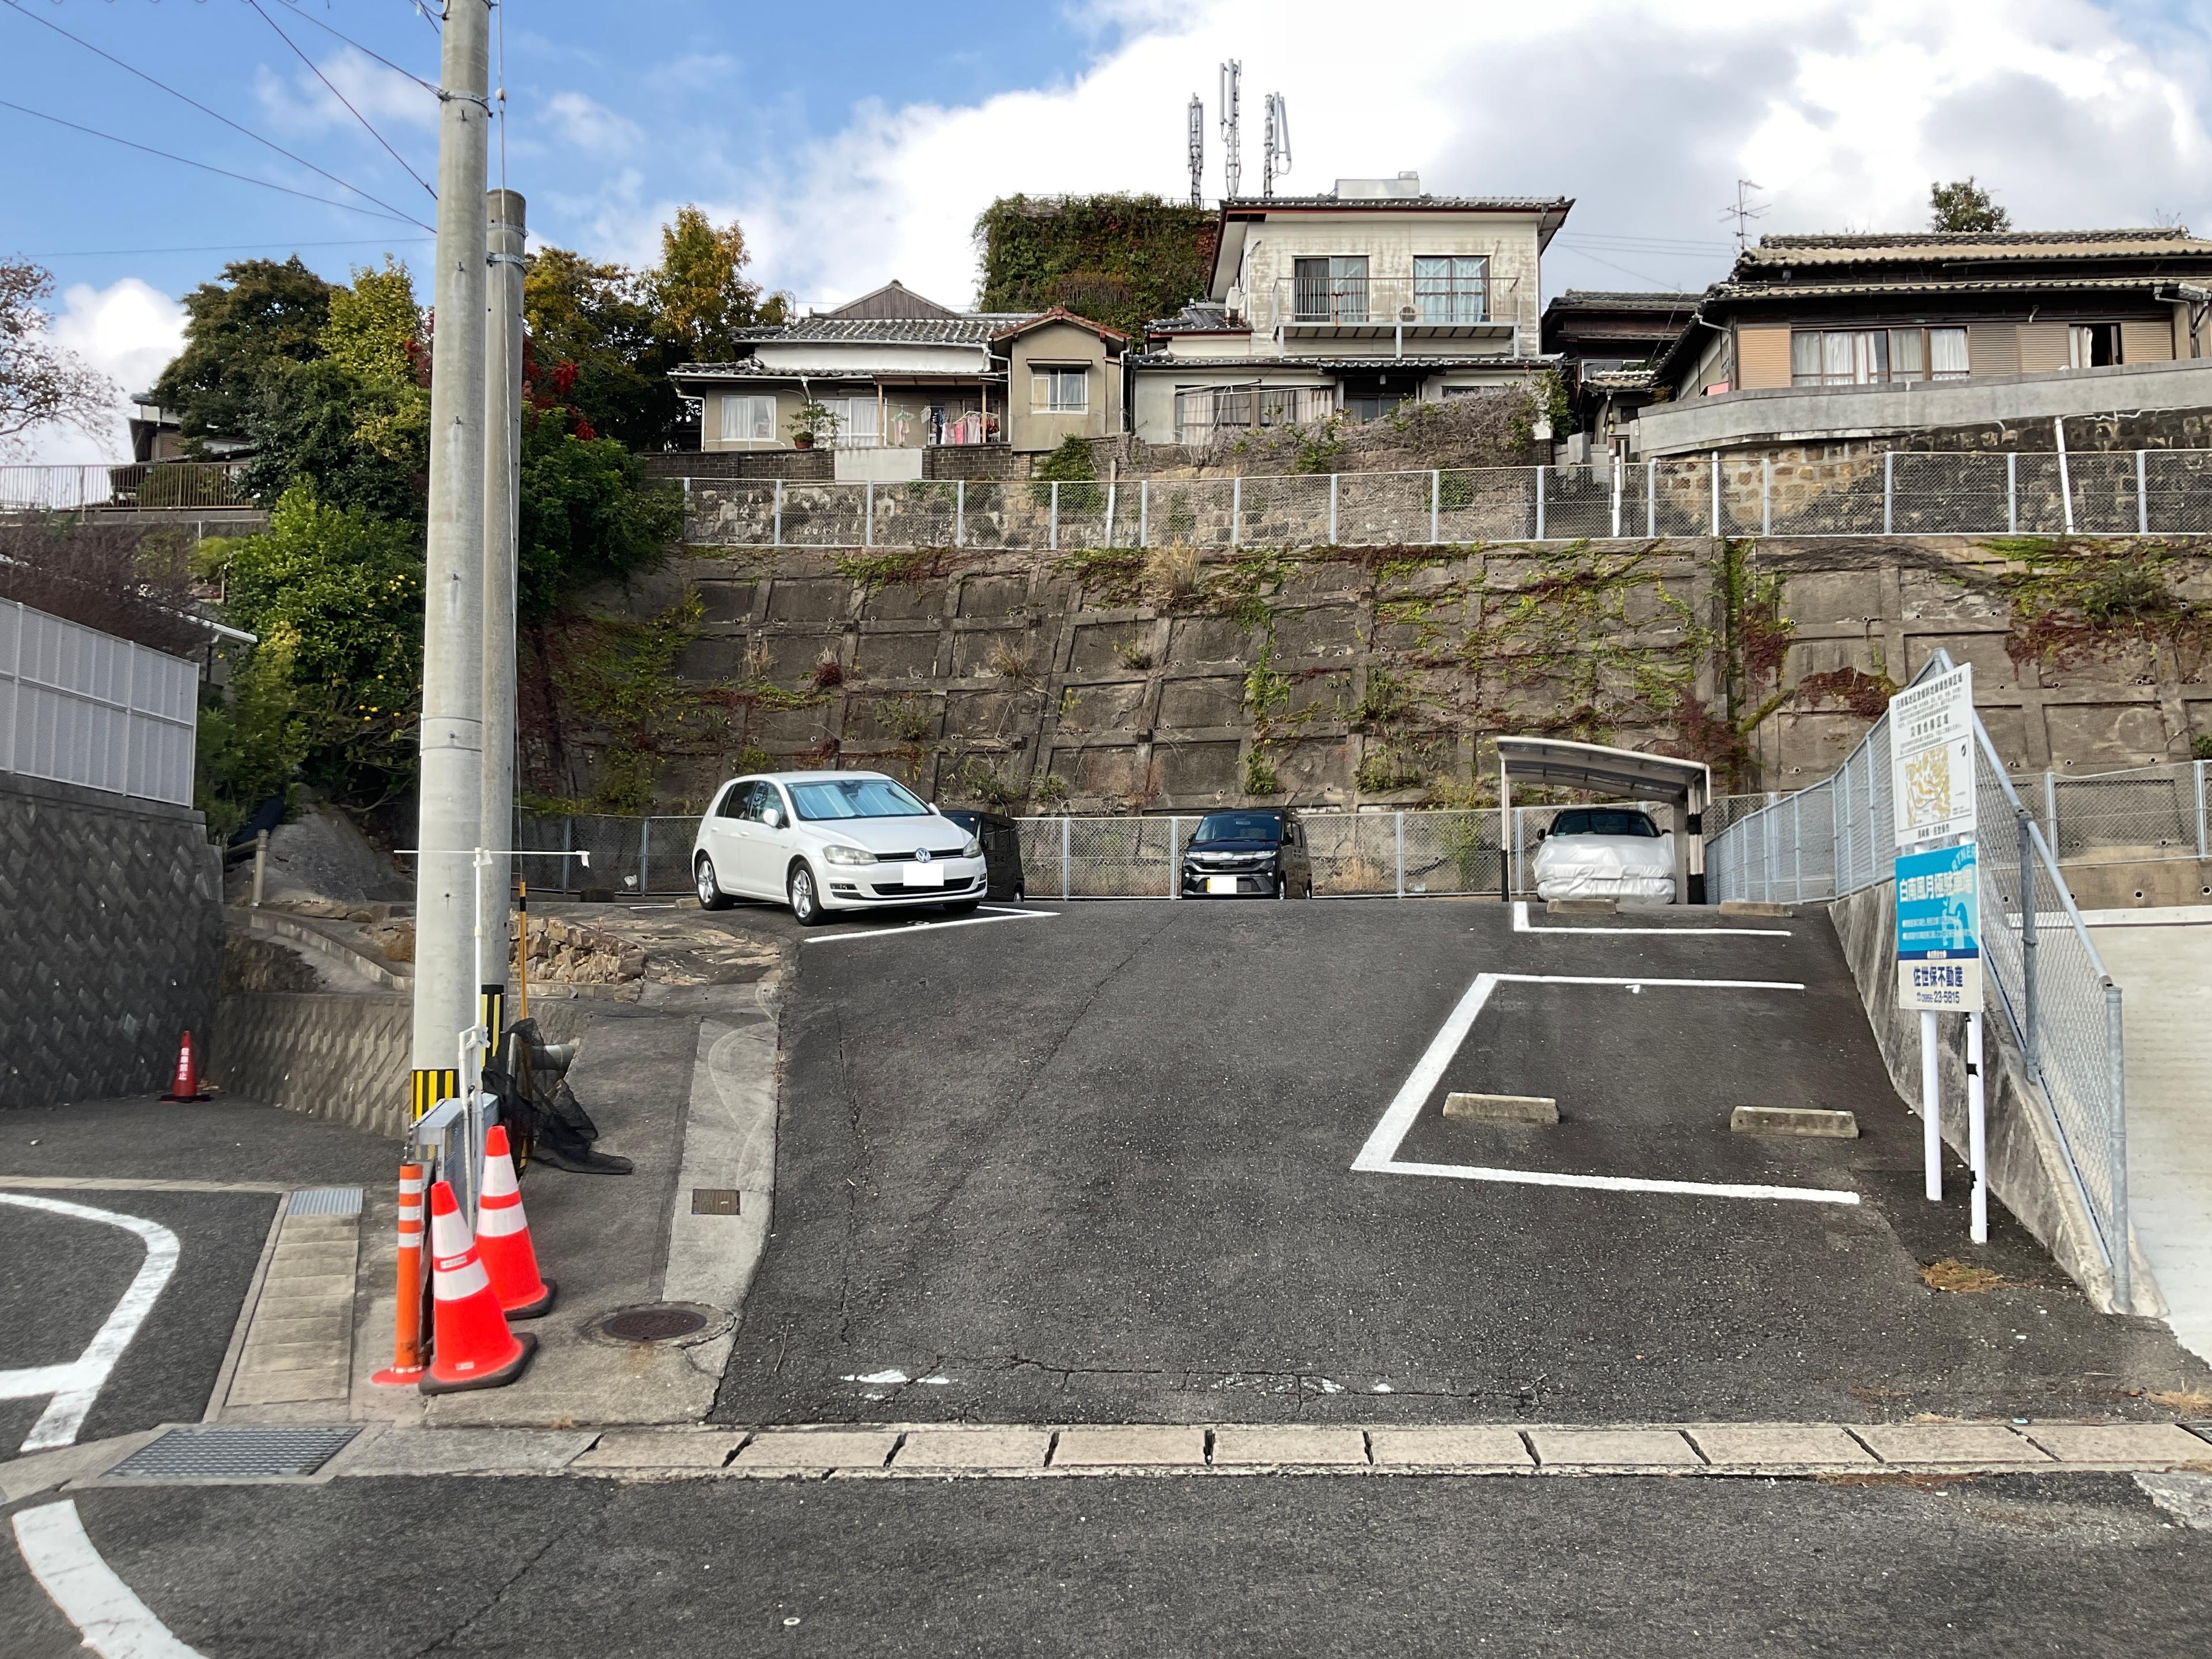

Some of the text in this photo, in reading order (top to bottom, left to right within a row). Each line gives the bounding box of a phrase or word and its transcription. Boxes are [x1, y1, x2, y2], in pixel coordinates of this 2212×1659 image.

[1914, 965, 1963, 987] 佐世保不動産
